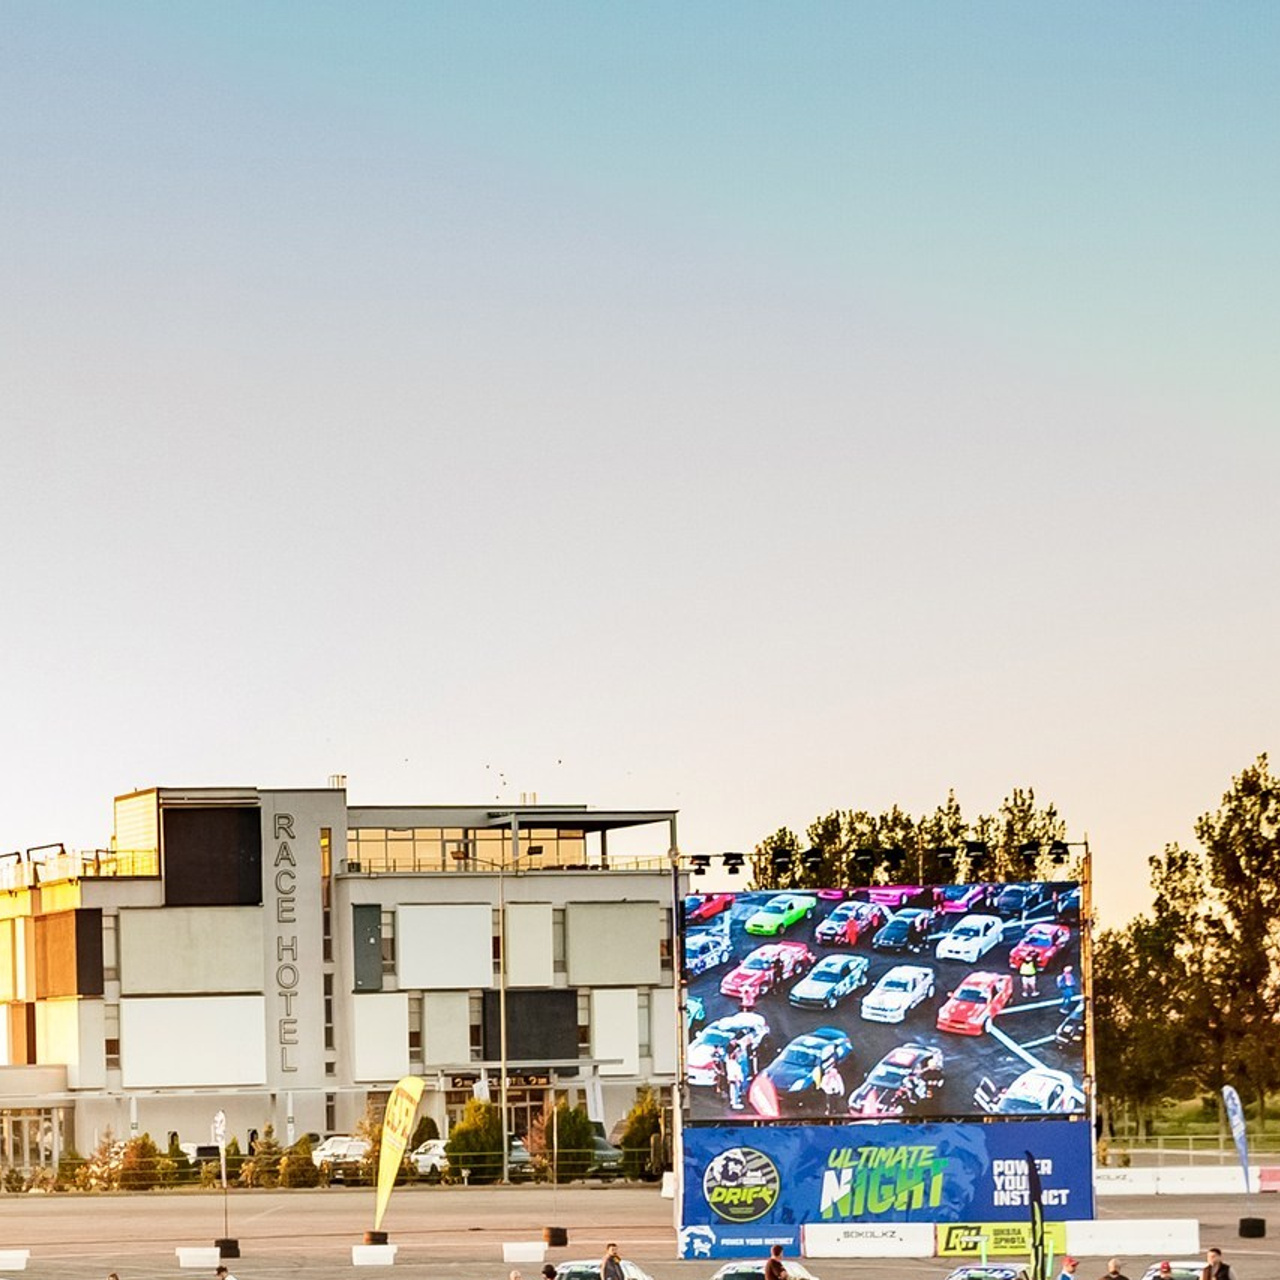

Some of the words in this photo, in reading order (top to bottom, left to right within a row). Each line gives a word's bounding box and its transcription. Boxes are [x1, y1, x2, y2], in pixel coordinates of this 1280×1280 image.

[274, 813, 297, 923] RACE
[276, 936, 299, 1072] HOTEL
[828, 1146, 937, 1169] ULTIMATE
[820, 1158, 948, 1219] NIGHT
[993, 1175, 1030, 1190] YOU
[993, 1189, 1070, 1206] INSTCT
